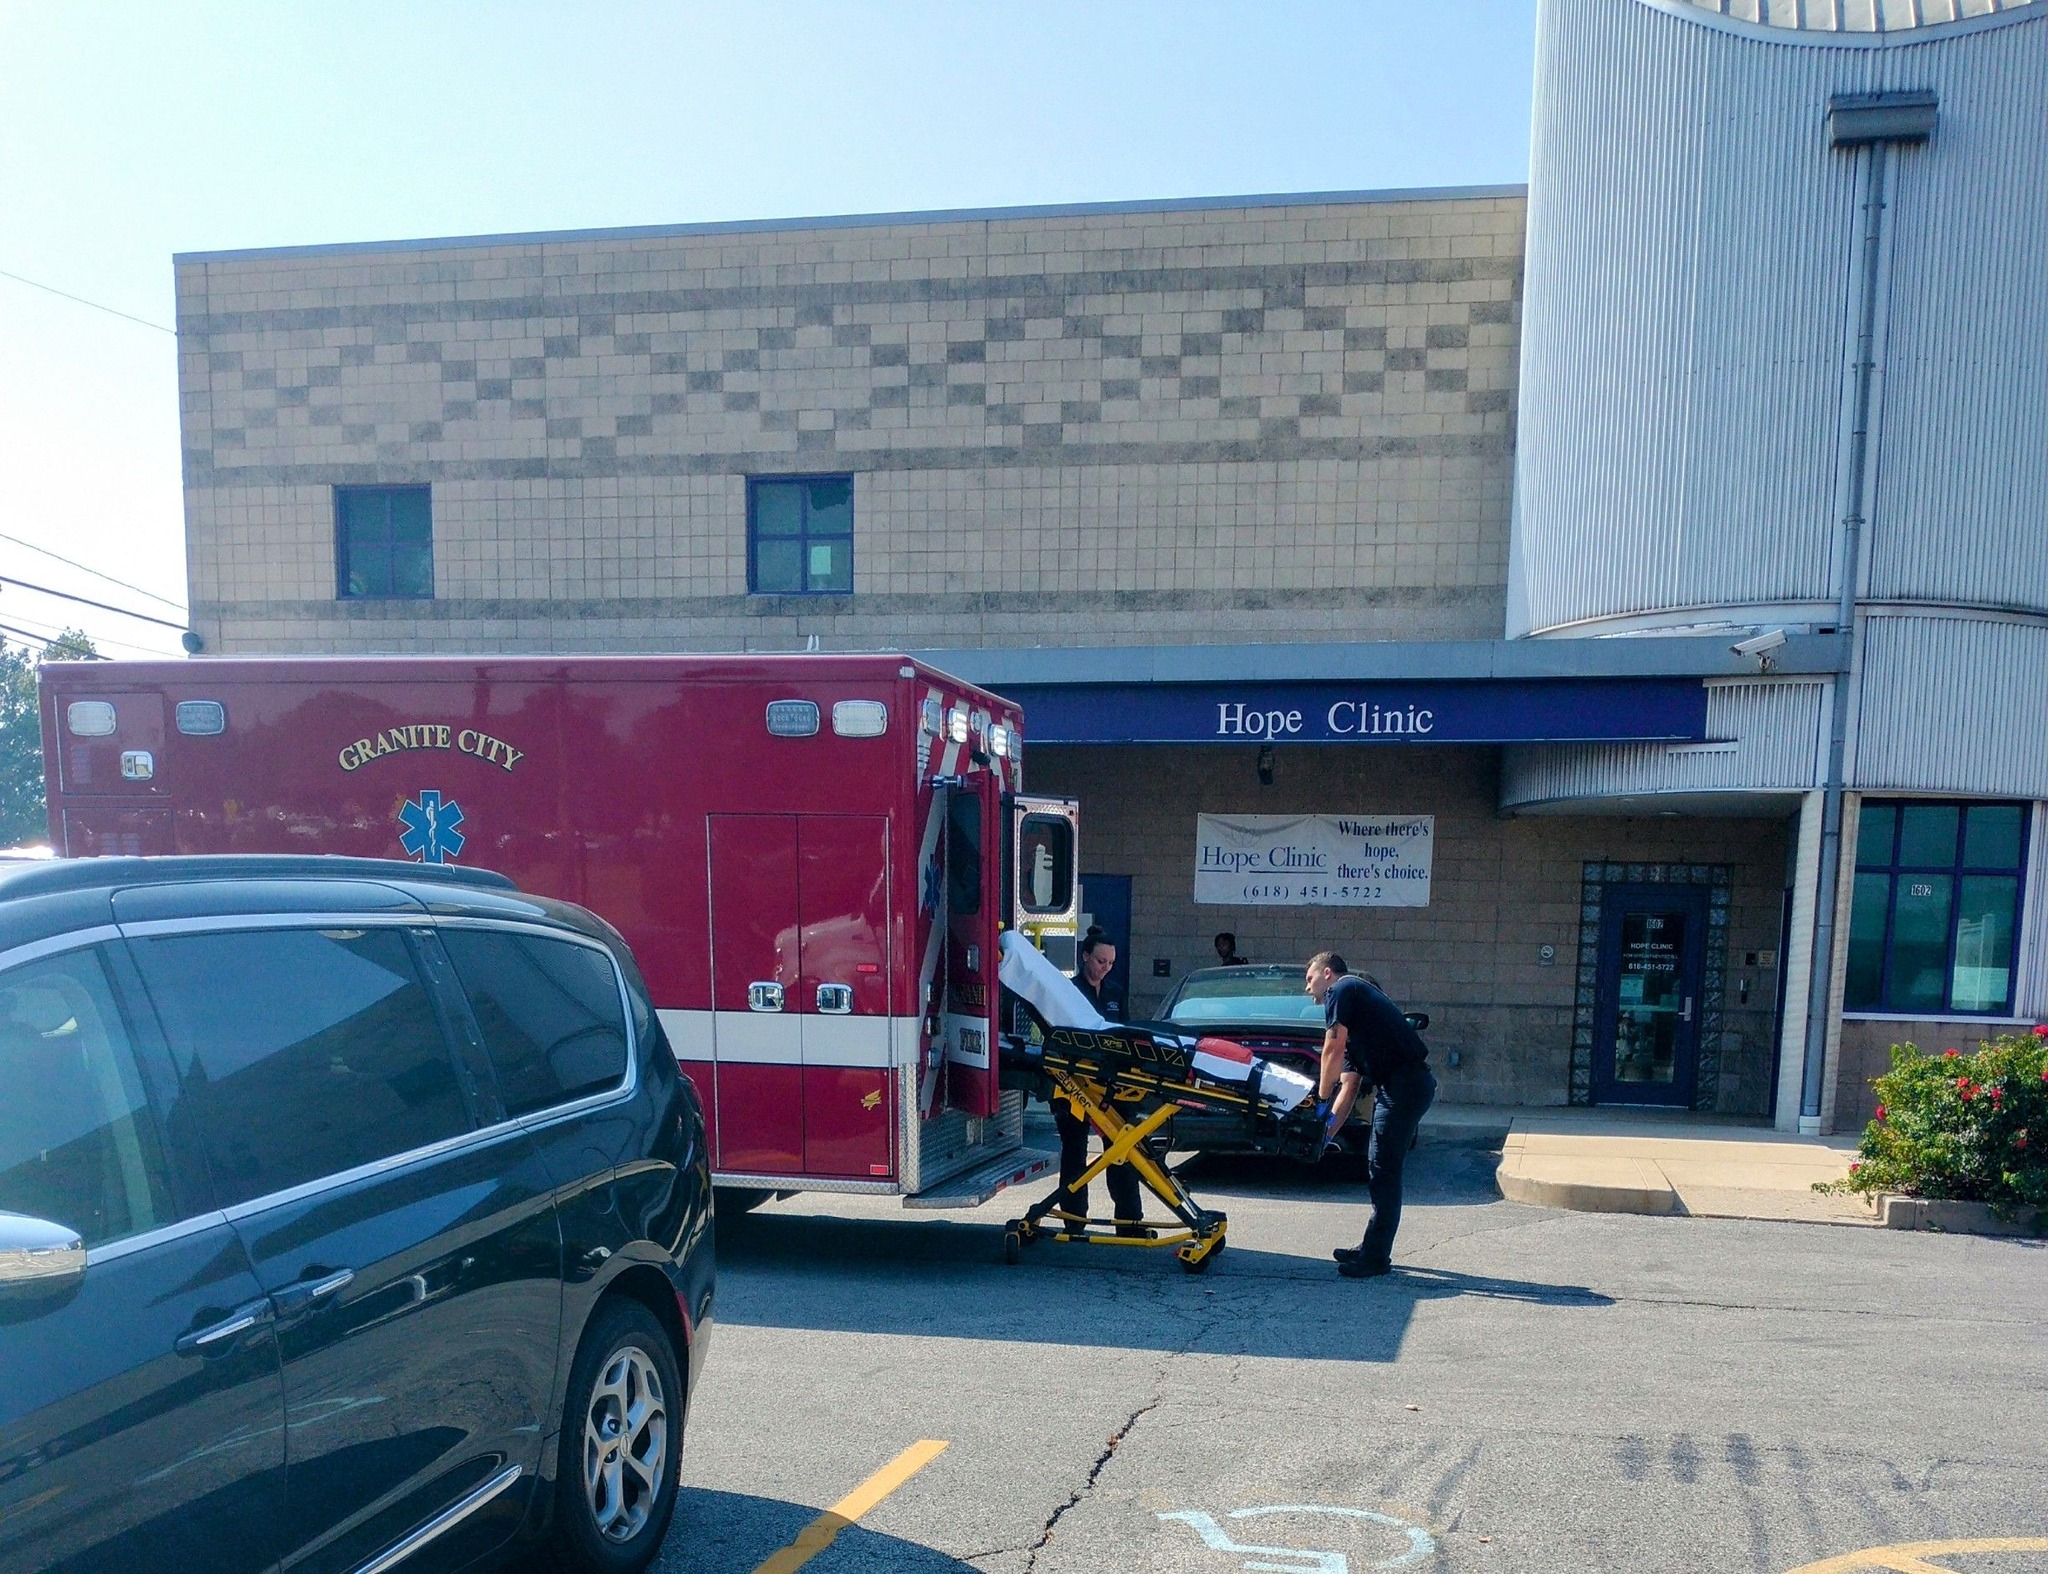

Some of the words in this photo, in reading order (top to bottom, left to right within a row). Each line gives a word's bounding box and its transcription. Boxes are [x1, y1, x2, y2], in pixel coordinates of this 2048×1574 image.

[1216, 703, 1303, 740] Hope
[1327, 701, 1434, 734] Clinic
[338, 724, 451, 771] GRANITE
[457, 729, 524, 772] CITY
[1338, 820, 1381, 836] Where
[1385, 821, 1429, 837] there's
[1202, 846, 1260, 874] Hope
[1268, 846, 1327, 868] Clinic
[1364, 843, 1399, 860] hope,
[1337, 863, 1380, 880] there's
[1384, 864, 1429, 880] choice.
[1243, 885, 1290, 899] (618)
[1300, 886, 1382, 899] 451-5722
[1912, 885, 1931, 896] 1602
[1630, 942, 1650, 950] HOPE
